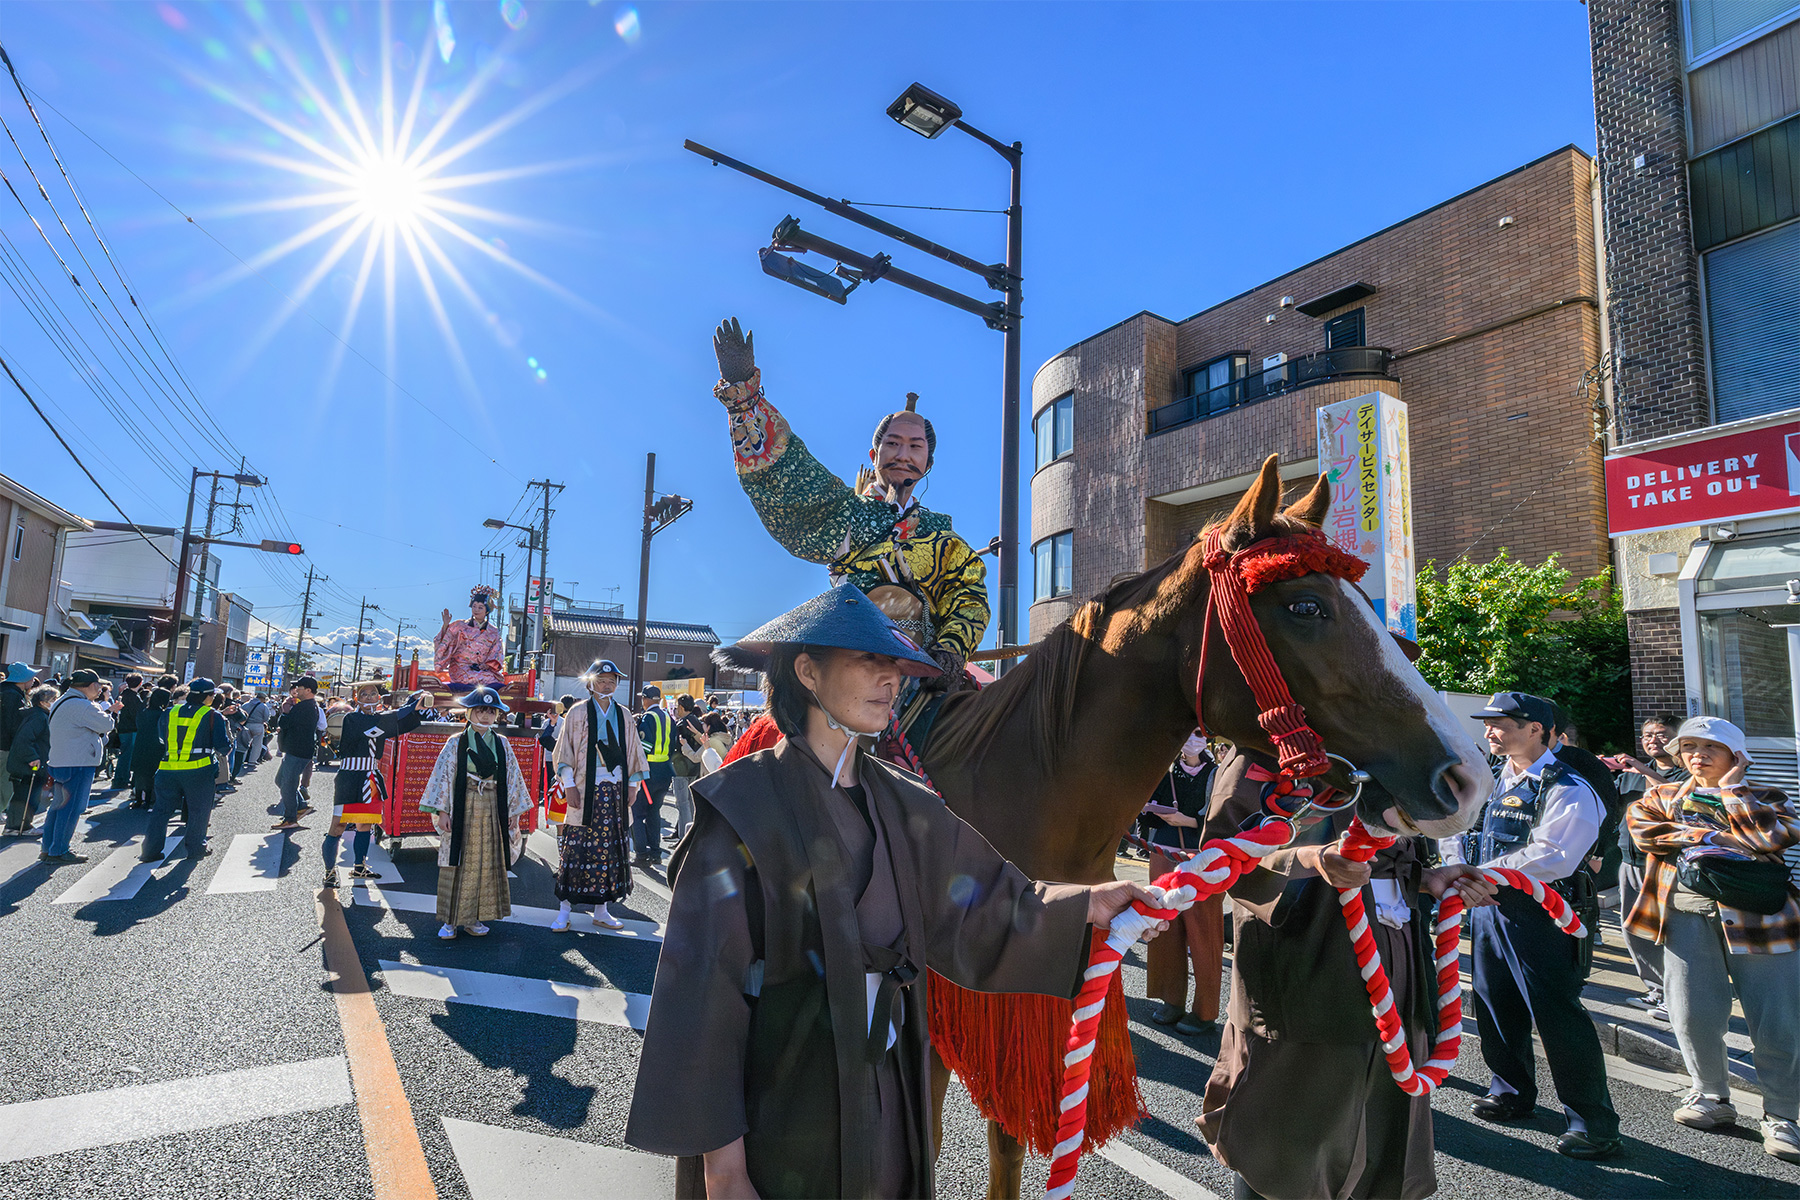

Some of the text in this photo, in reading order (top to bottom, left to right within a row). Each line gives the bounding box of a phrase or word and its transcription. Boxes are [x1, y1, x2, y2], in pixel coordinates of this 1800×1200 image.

[1332, 409, 1357, 551] メープル岩槻
[1359, 403, 1376, 531] デイサービスセンター
[1386, 407, 1405, 602] メープル岩槻本町
[1626, 453, 1759, 490] DELIVERY
[1628, 474, 1761, 509] TAKE OUT
